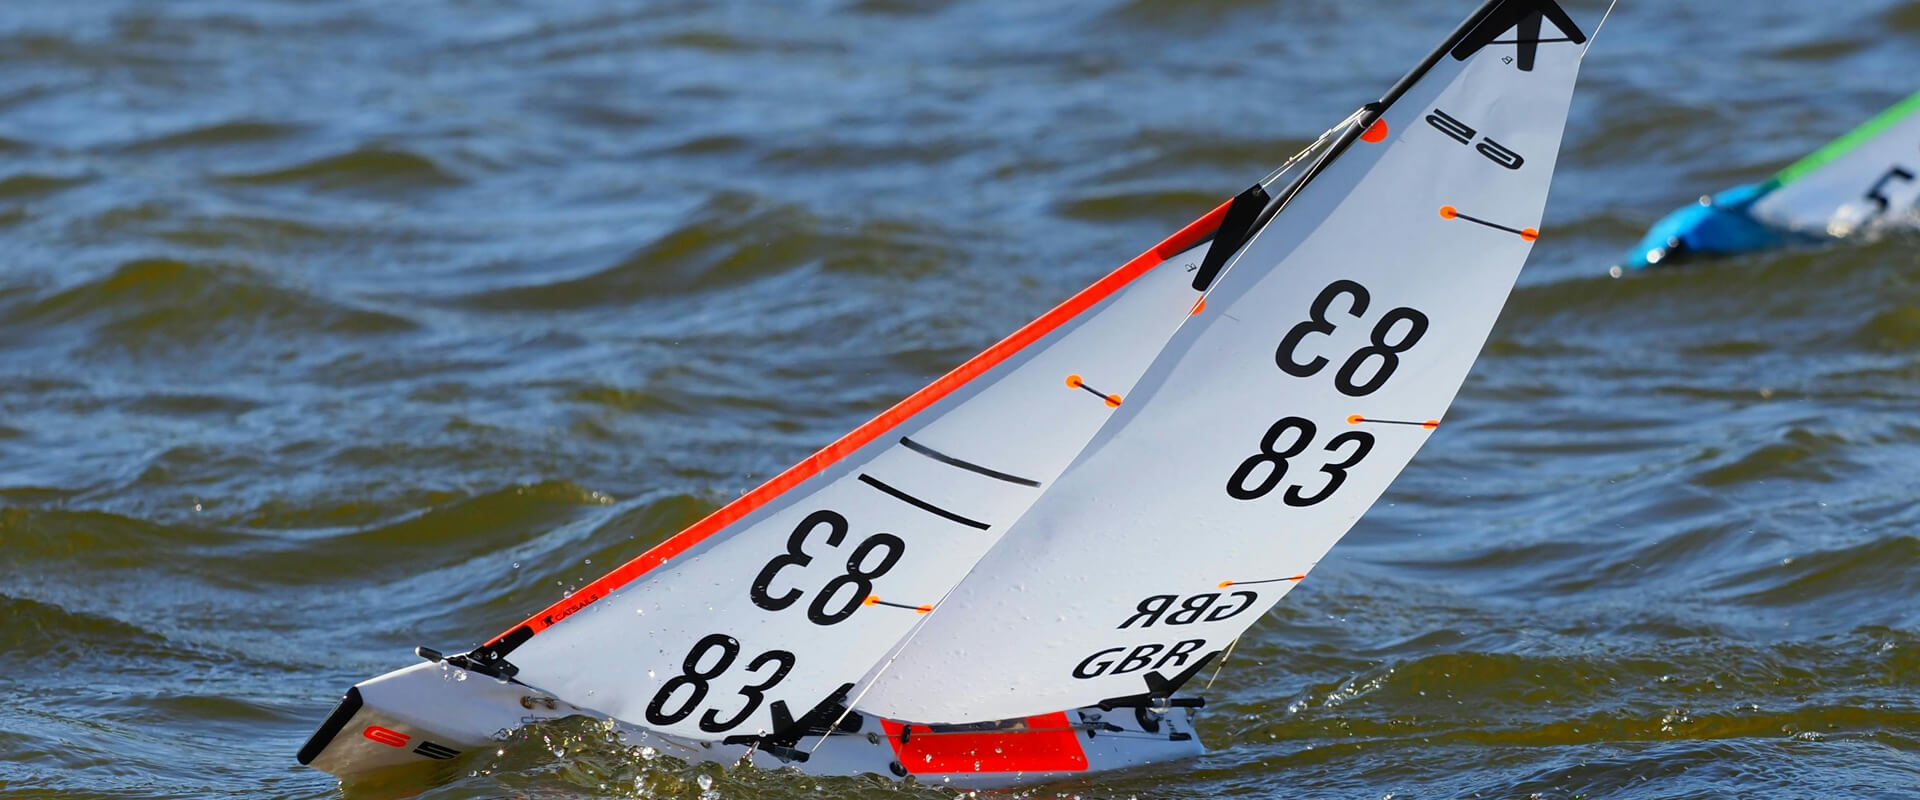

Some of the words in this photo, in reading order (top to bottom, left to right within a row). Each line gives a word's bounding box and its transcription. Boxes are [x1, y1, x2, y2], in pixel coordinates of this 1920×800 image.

[1226, 416, 1376, 508] 83
[645, 633, 796, 733] 83
[1072, 638, 1207, 680] GBR
